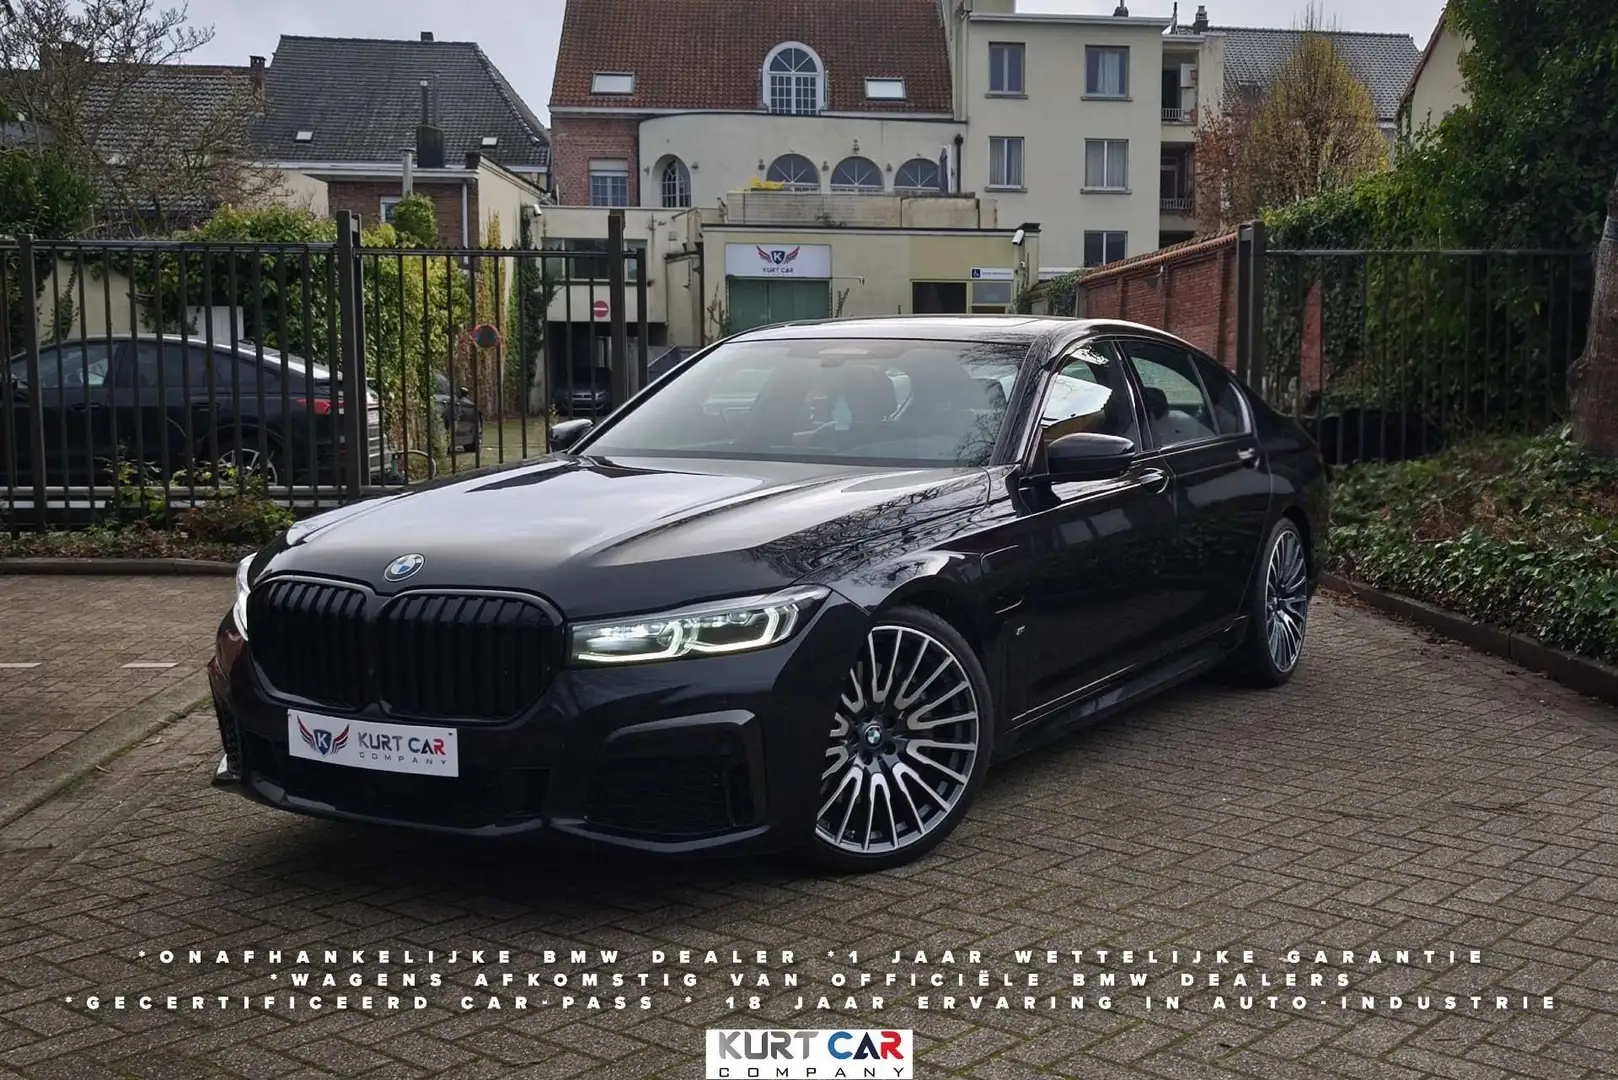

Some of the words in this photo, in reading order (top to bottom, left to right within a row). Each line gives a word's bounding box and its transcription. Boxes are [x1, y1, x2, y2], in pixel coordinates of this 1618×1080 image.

[358, 731, 402, 751] KURT
[408, 737, 446, 756] CAR
[359, 752, 446, 765] COMPANY
